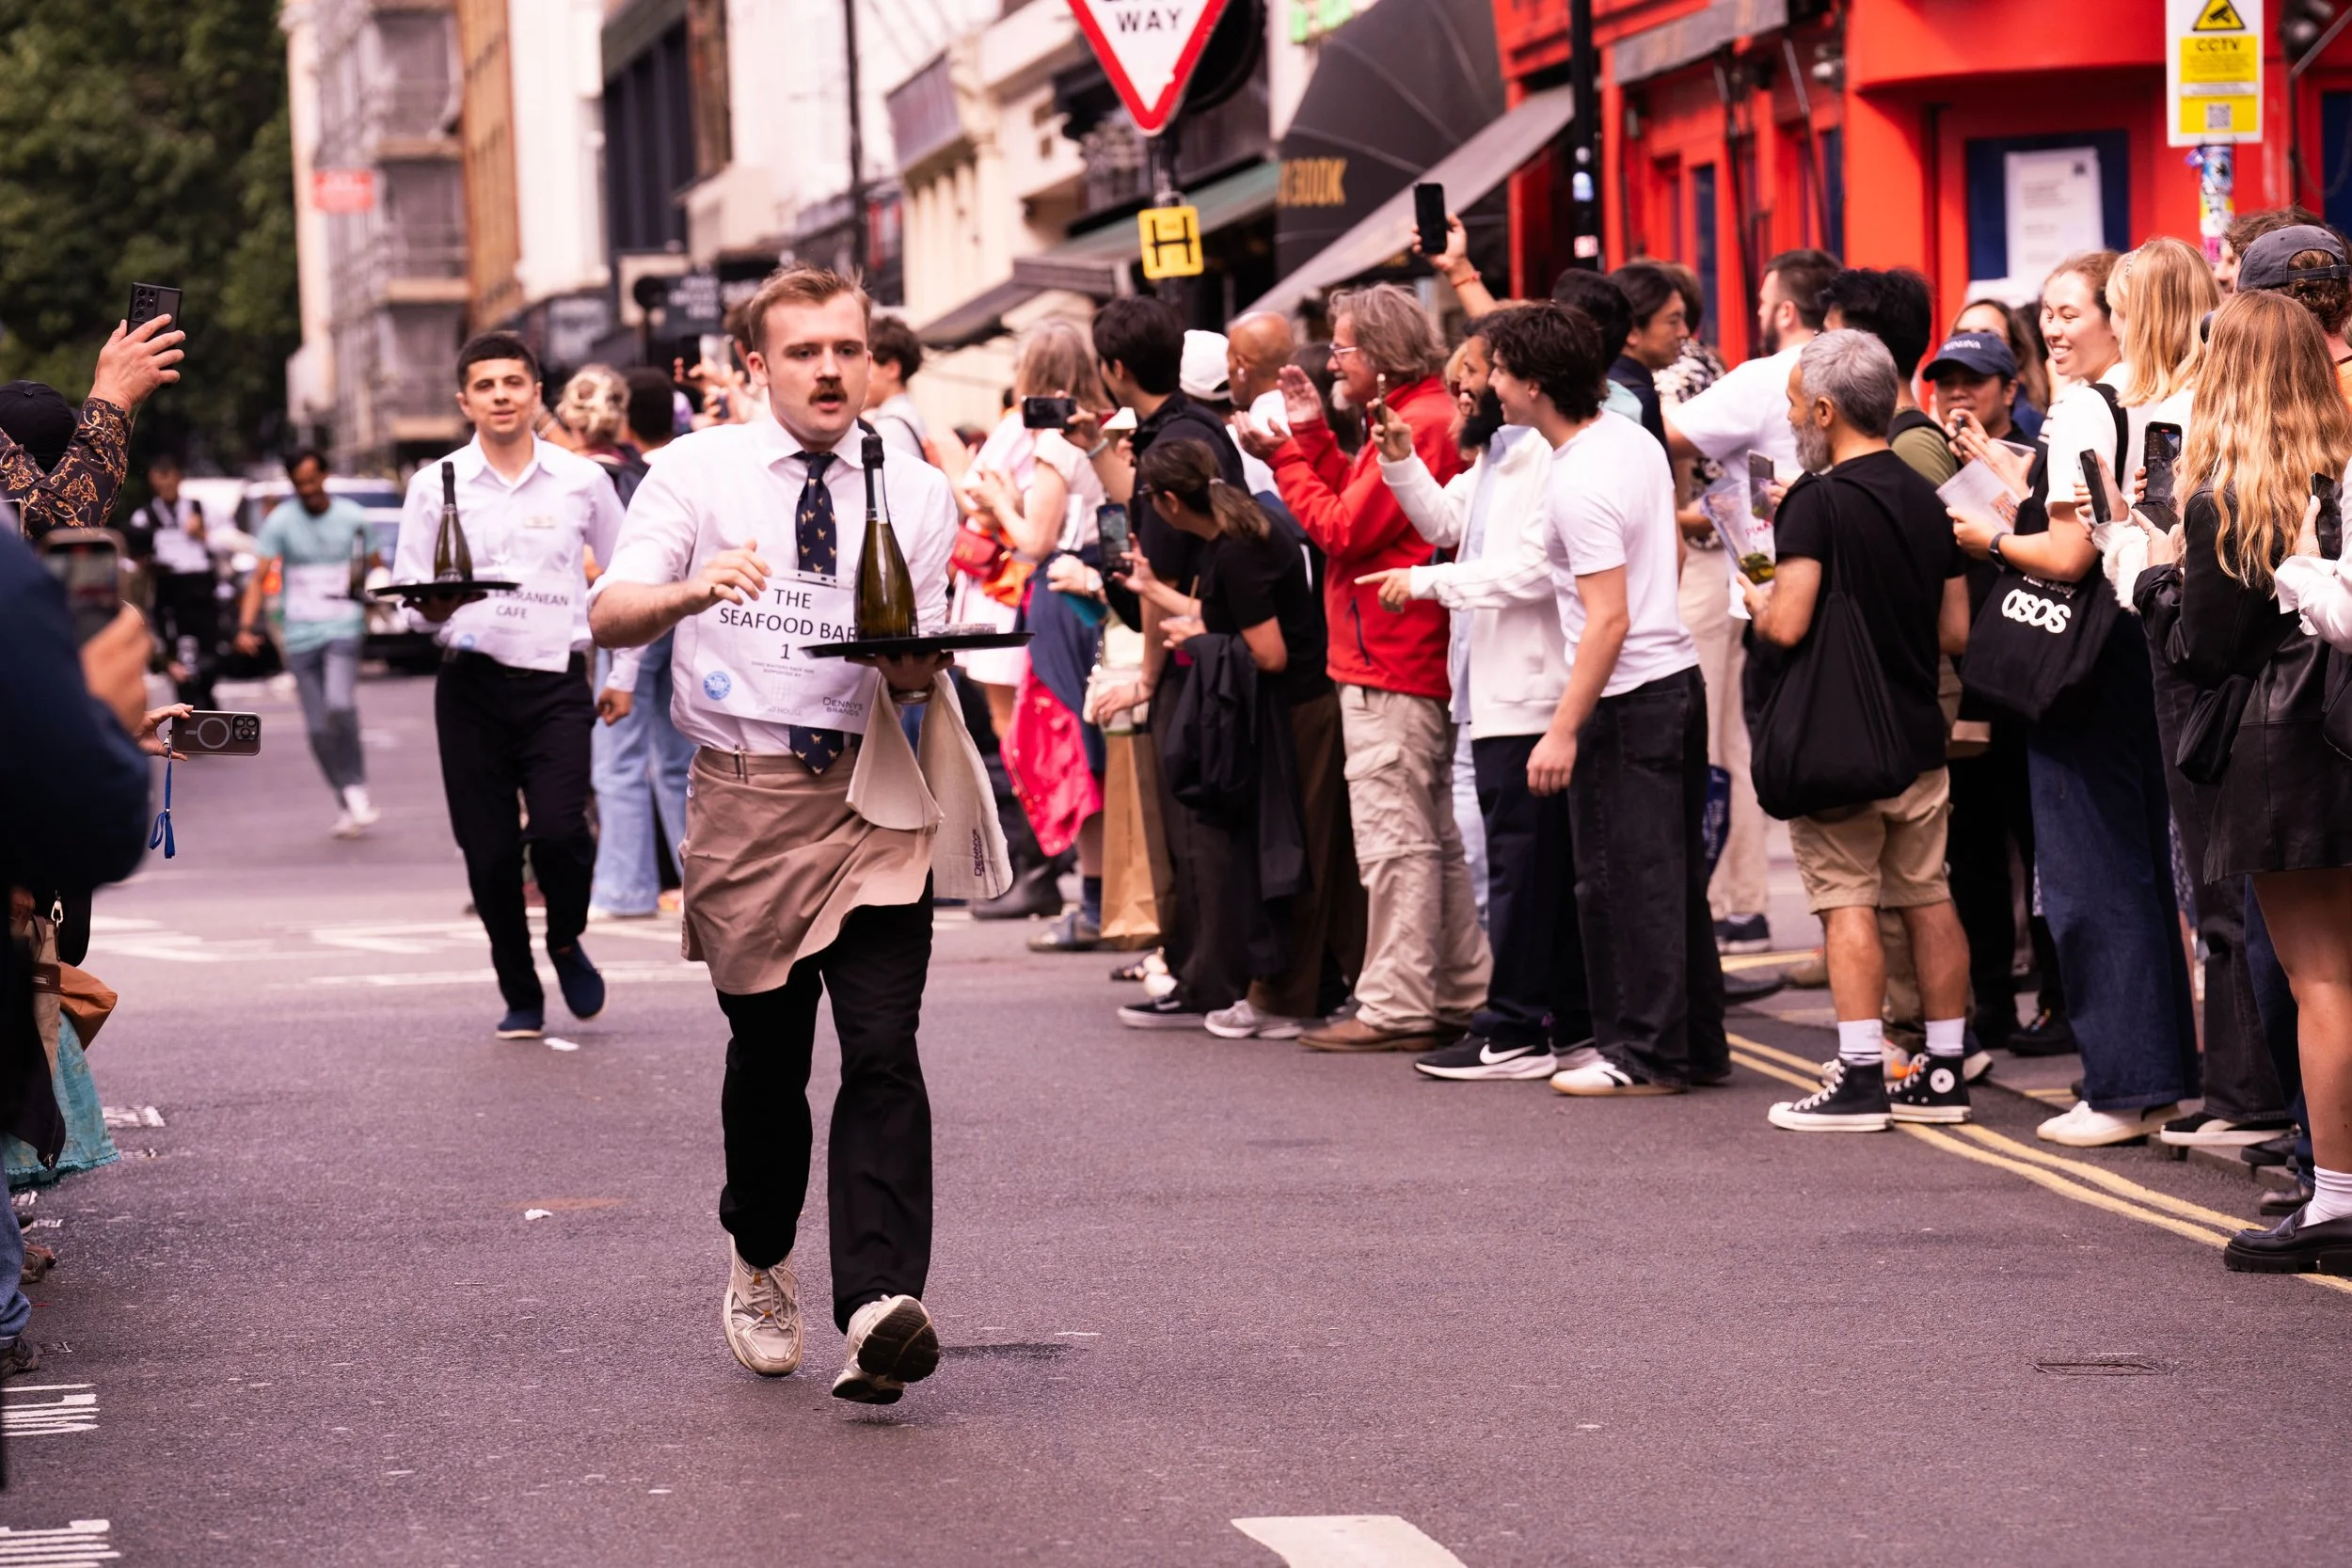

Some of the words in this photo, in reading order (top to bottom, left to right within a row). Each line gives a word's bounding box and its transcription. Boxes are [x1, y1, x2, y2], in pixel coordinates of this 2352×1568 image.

[1116, 8, 1184, 32] WAY
[2196, 38, 2240, 52] CCTV
[773, 588, 813, 610] THE
[496, 604, 528, 619] CAFE
[719, 607, 814, 636] SEAFOOD
[819, 622, 858, 643] BAR
[780, 643, 790, 659] 1
